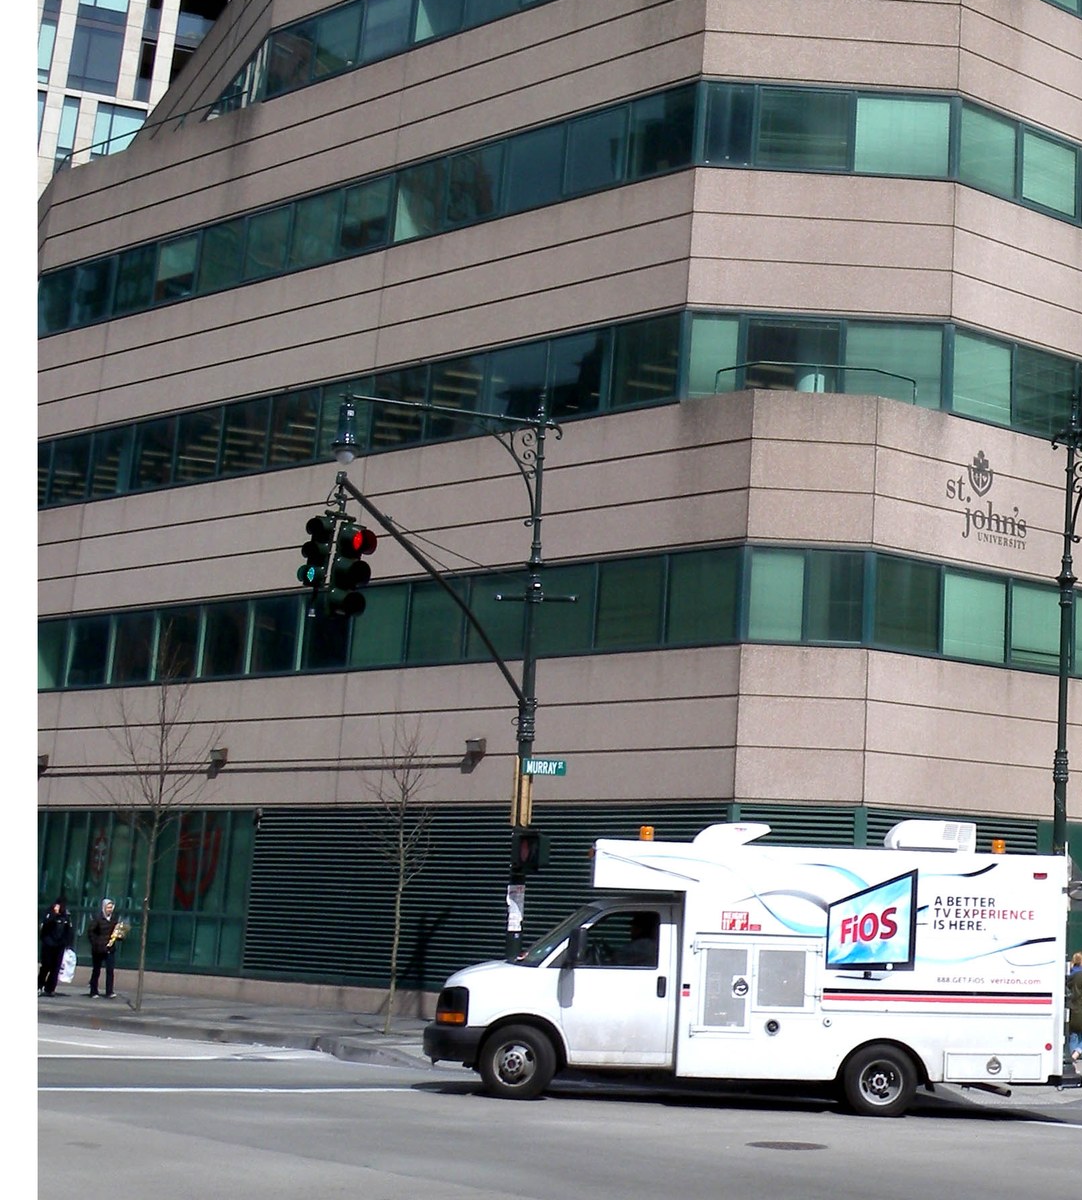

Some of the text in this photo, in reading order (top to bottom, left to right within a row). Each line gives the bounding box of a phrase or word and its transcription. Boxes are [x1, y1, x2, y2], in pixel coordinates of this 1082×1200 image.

[946, 475, 972, 502] st.
[962, 501, 1027, 539] john's
[977, 532, 1027, 550] UNIVERSITY
[526, 760, 557, 775] MURRAY
[934, 896, 996, 908] A BETTER
[934, 908, 1035, 921] TV EXPERIENCE
[840, 907, 898, 945] FiOS
[933, 919, 987, 932] IS HERE.
[990, 976, 1042, 986] verizon.com
